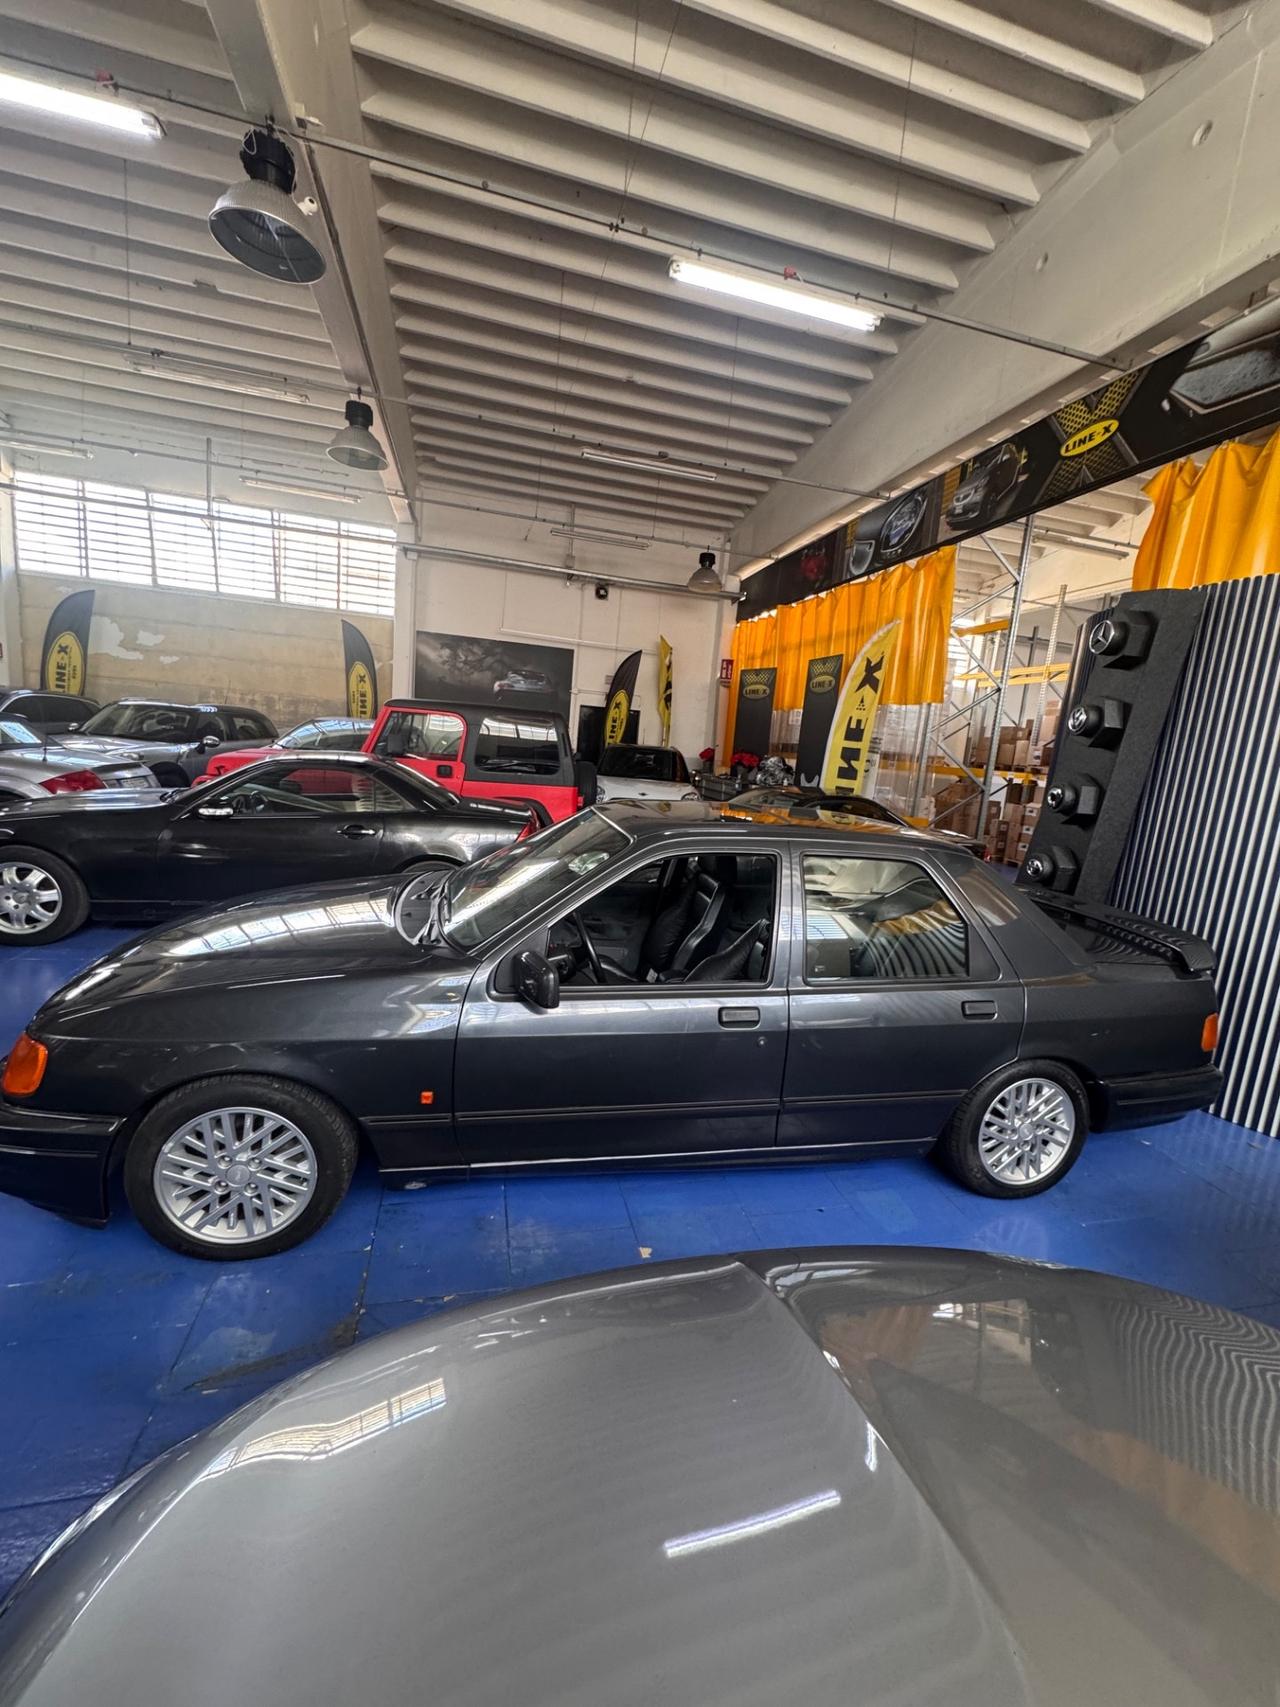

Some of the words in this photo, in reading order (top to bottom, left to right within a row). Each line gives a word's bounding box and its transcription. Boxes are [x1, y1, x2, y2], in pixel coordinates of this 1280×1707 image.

[1064, 422, 1114, 454] LINE-X
[55, 643, 69, 692] INE-X
[608, 700, 621, 740] INE-X
